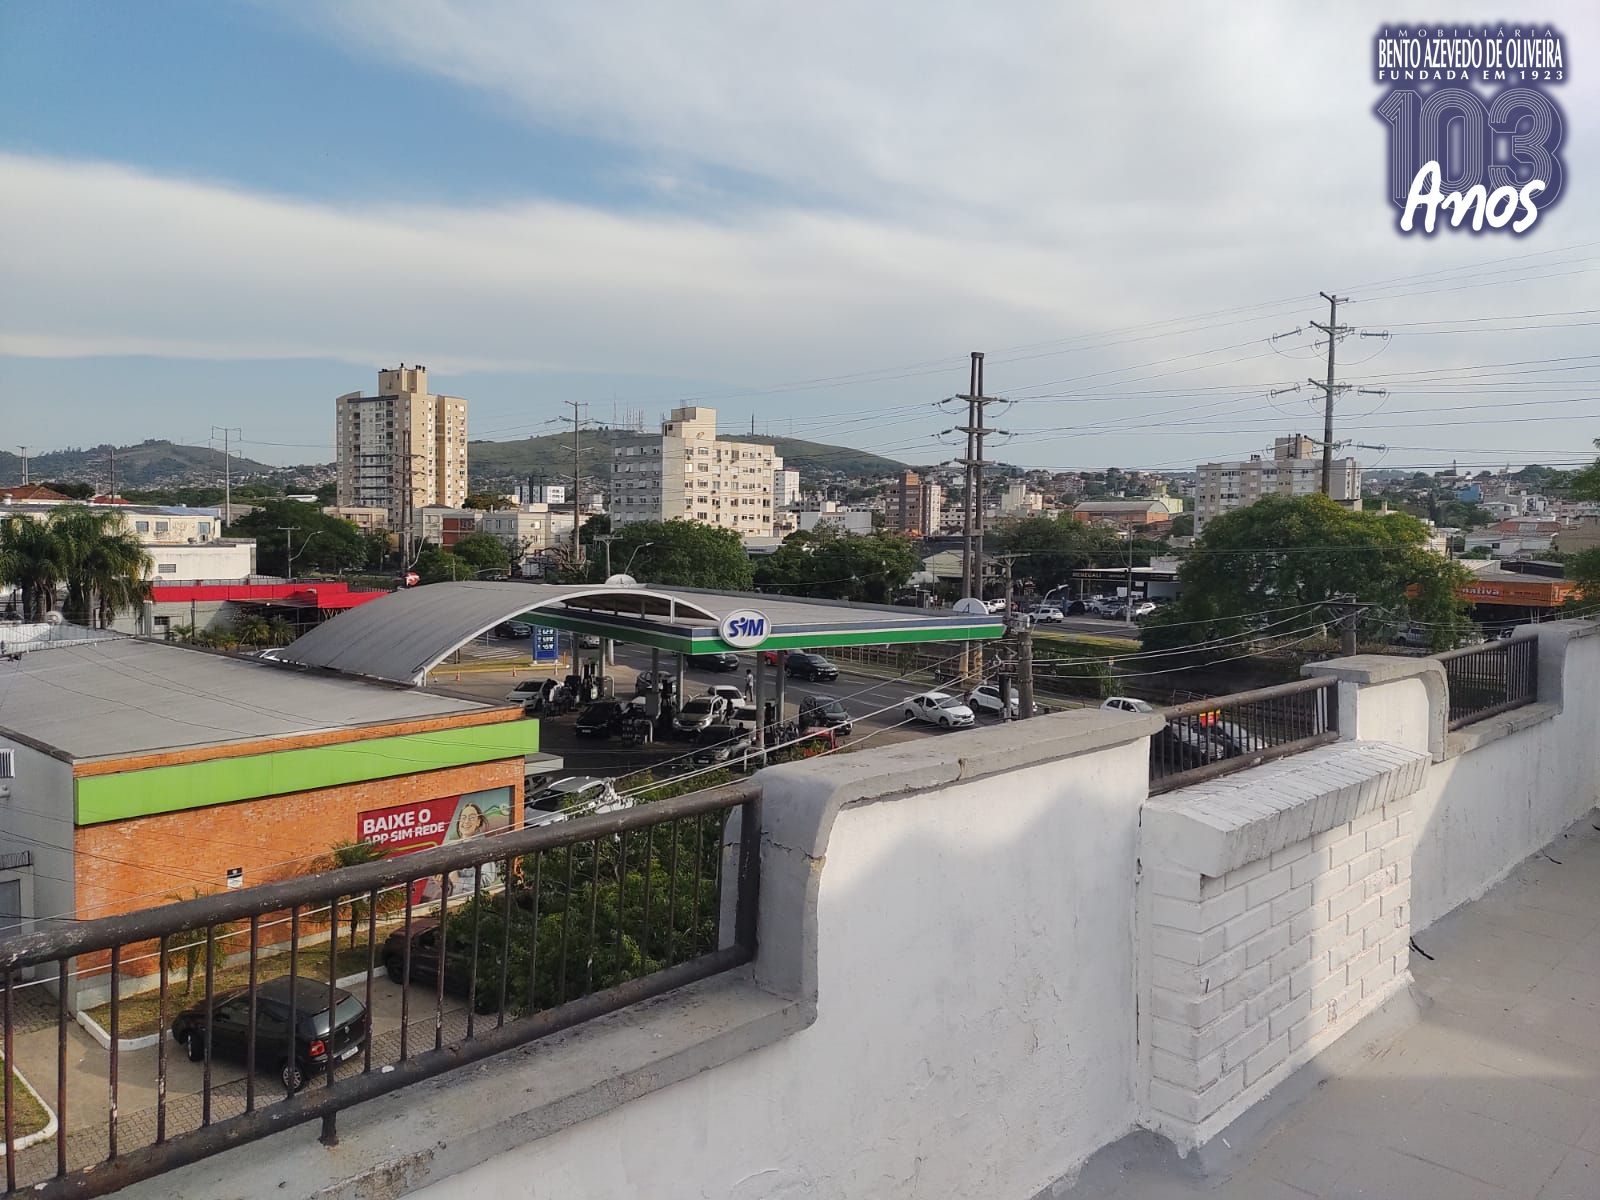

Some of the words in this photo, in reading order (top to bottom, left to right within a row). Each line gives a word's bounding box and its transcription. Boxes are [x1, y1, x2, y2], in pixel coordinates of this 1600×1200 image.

[728, 617, 764, 637] SIM
[363, 811, 415, 834] BAIXE
[418, 808, 431, 823] O
[391, 828, 413, 842] SIM
[415, 822, 445, 837] REDE
